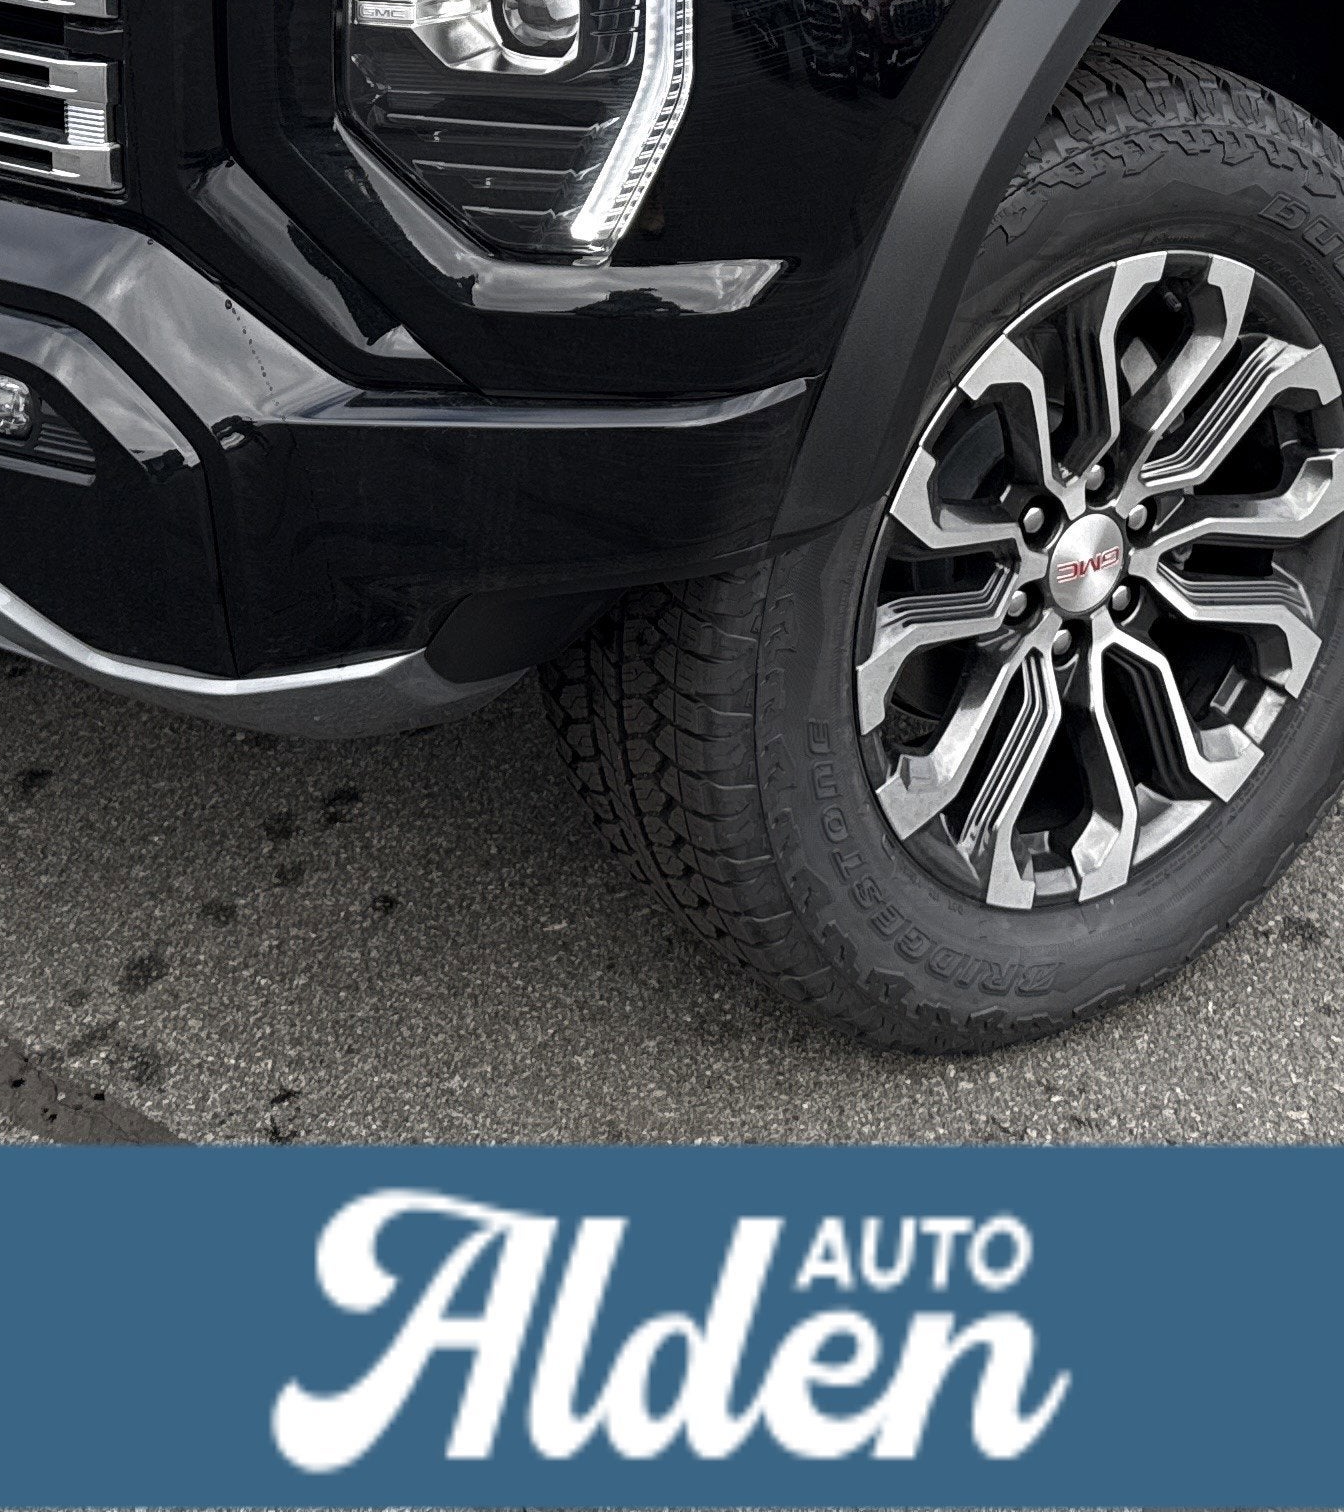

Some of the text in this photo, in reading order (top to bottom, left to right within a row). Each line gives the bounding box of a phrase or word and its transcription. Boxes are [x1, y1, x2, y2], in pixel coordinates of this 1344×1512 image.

[360, 5, 406, 18] GMC
[1056, 545, 1120, 584] GMC
[808, 718, 1061, 995] BRIDGESTONE
